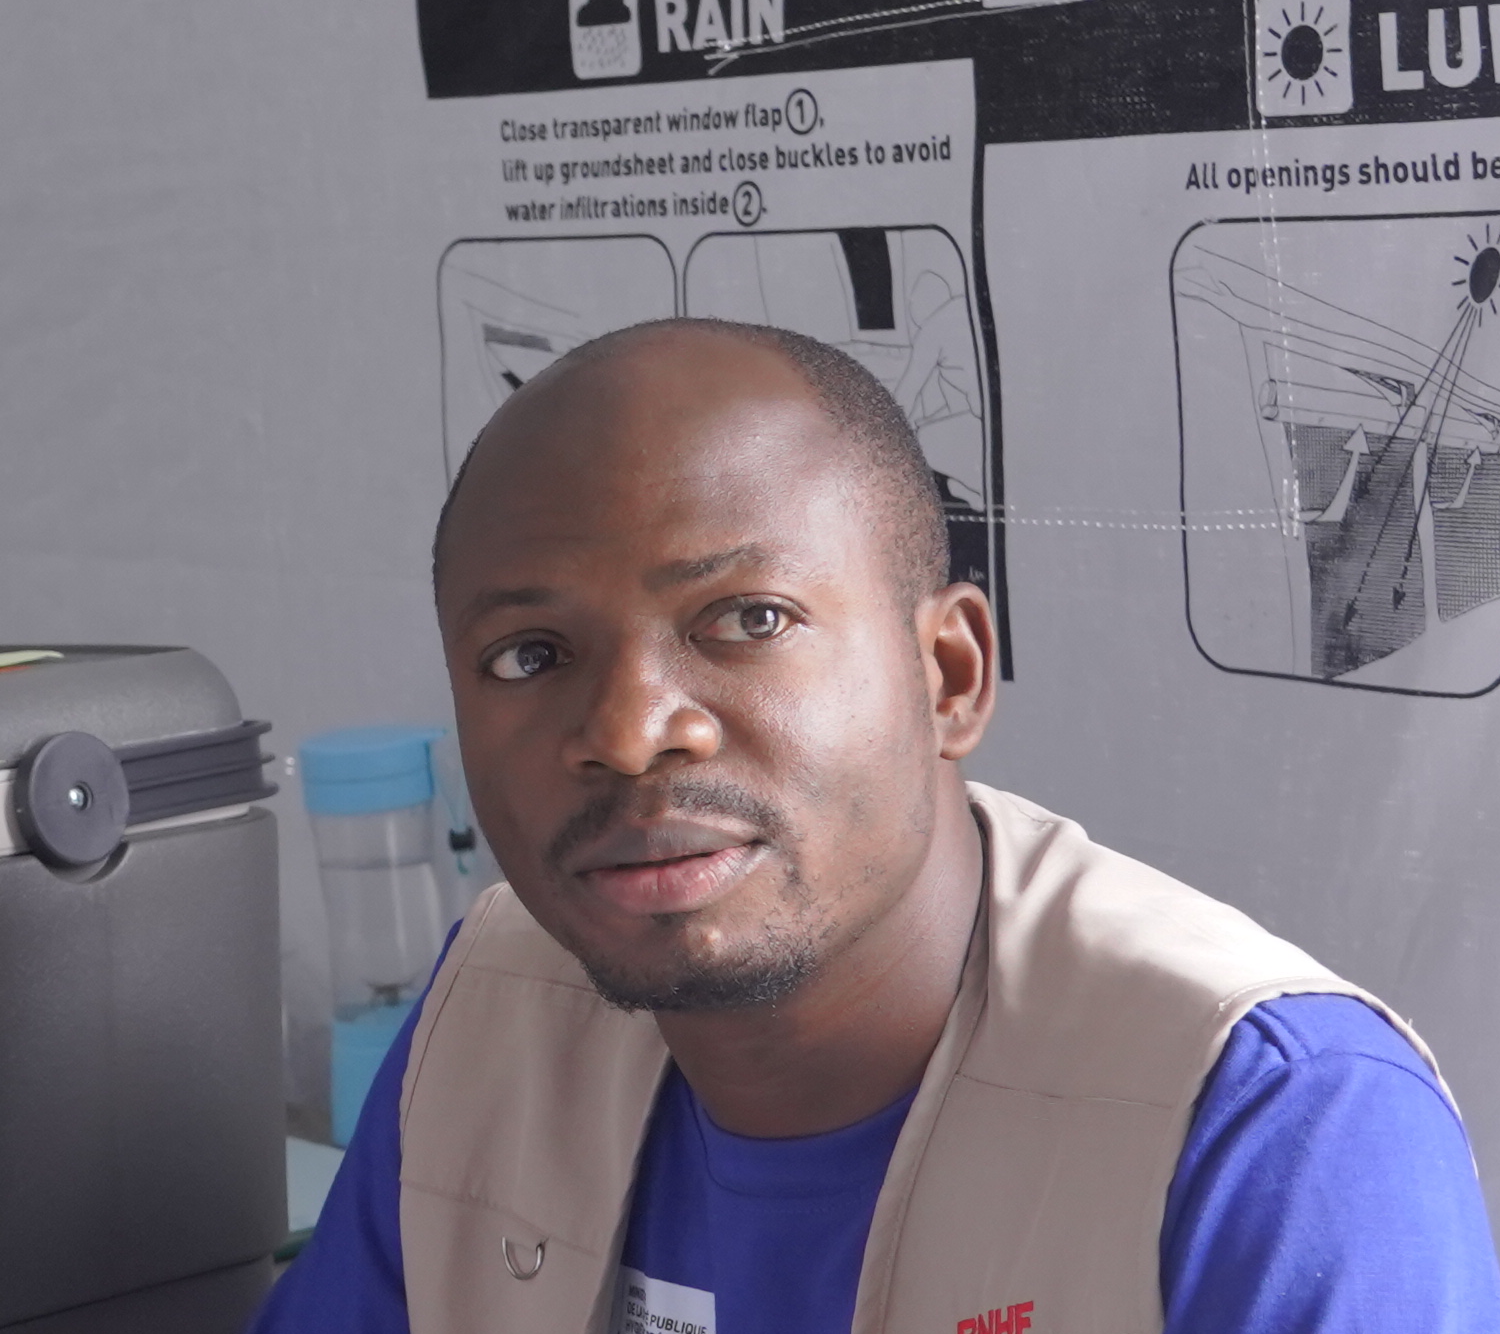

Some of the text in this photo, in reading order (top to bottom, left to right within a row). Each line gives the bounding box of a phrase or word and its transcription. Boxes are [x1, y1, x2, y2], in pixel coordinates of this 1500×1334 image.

[501, 119, 548, 142] Close
[553, 110, 662, 142] transparent
[667, 106, 738, 132] window
[744, 103, 783, 132] flap
[502, 135, 952, 185] lift up groundsheet and close buckles to avoid
[1185, 162, 1219, 191] All
[1227, 159, 1351, 194] openings
[1358, 151, 1460, 186] should
[505, 201, 556, 222] water
[560, 194, 668, 220] infiltrations
[672, 191, 729, 216] inside
